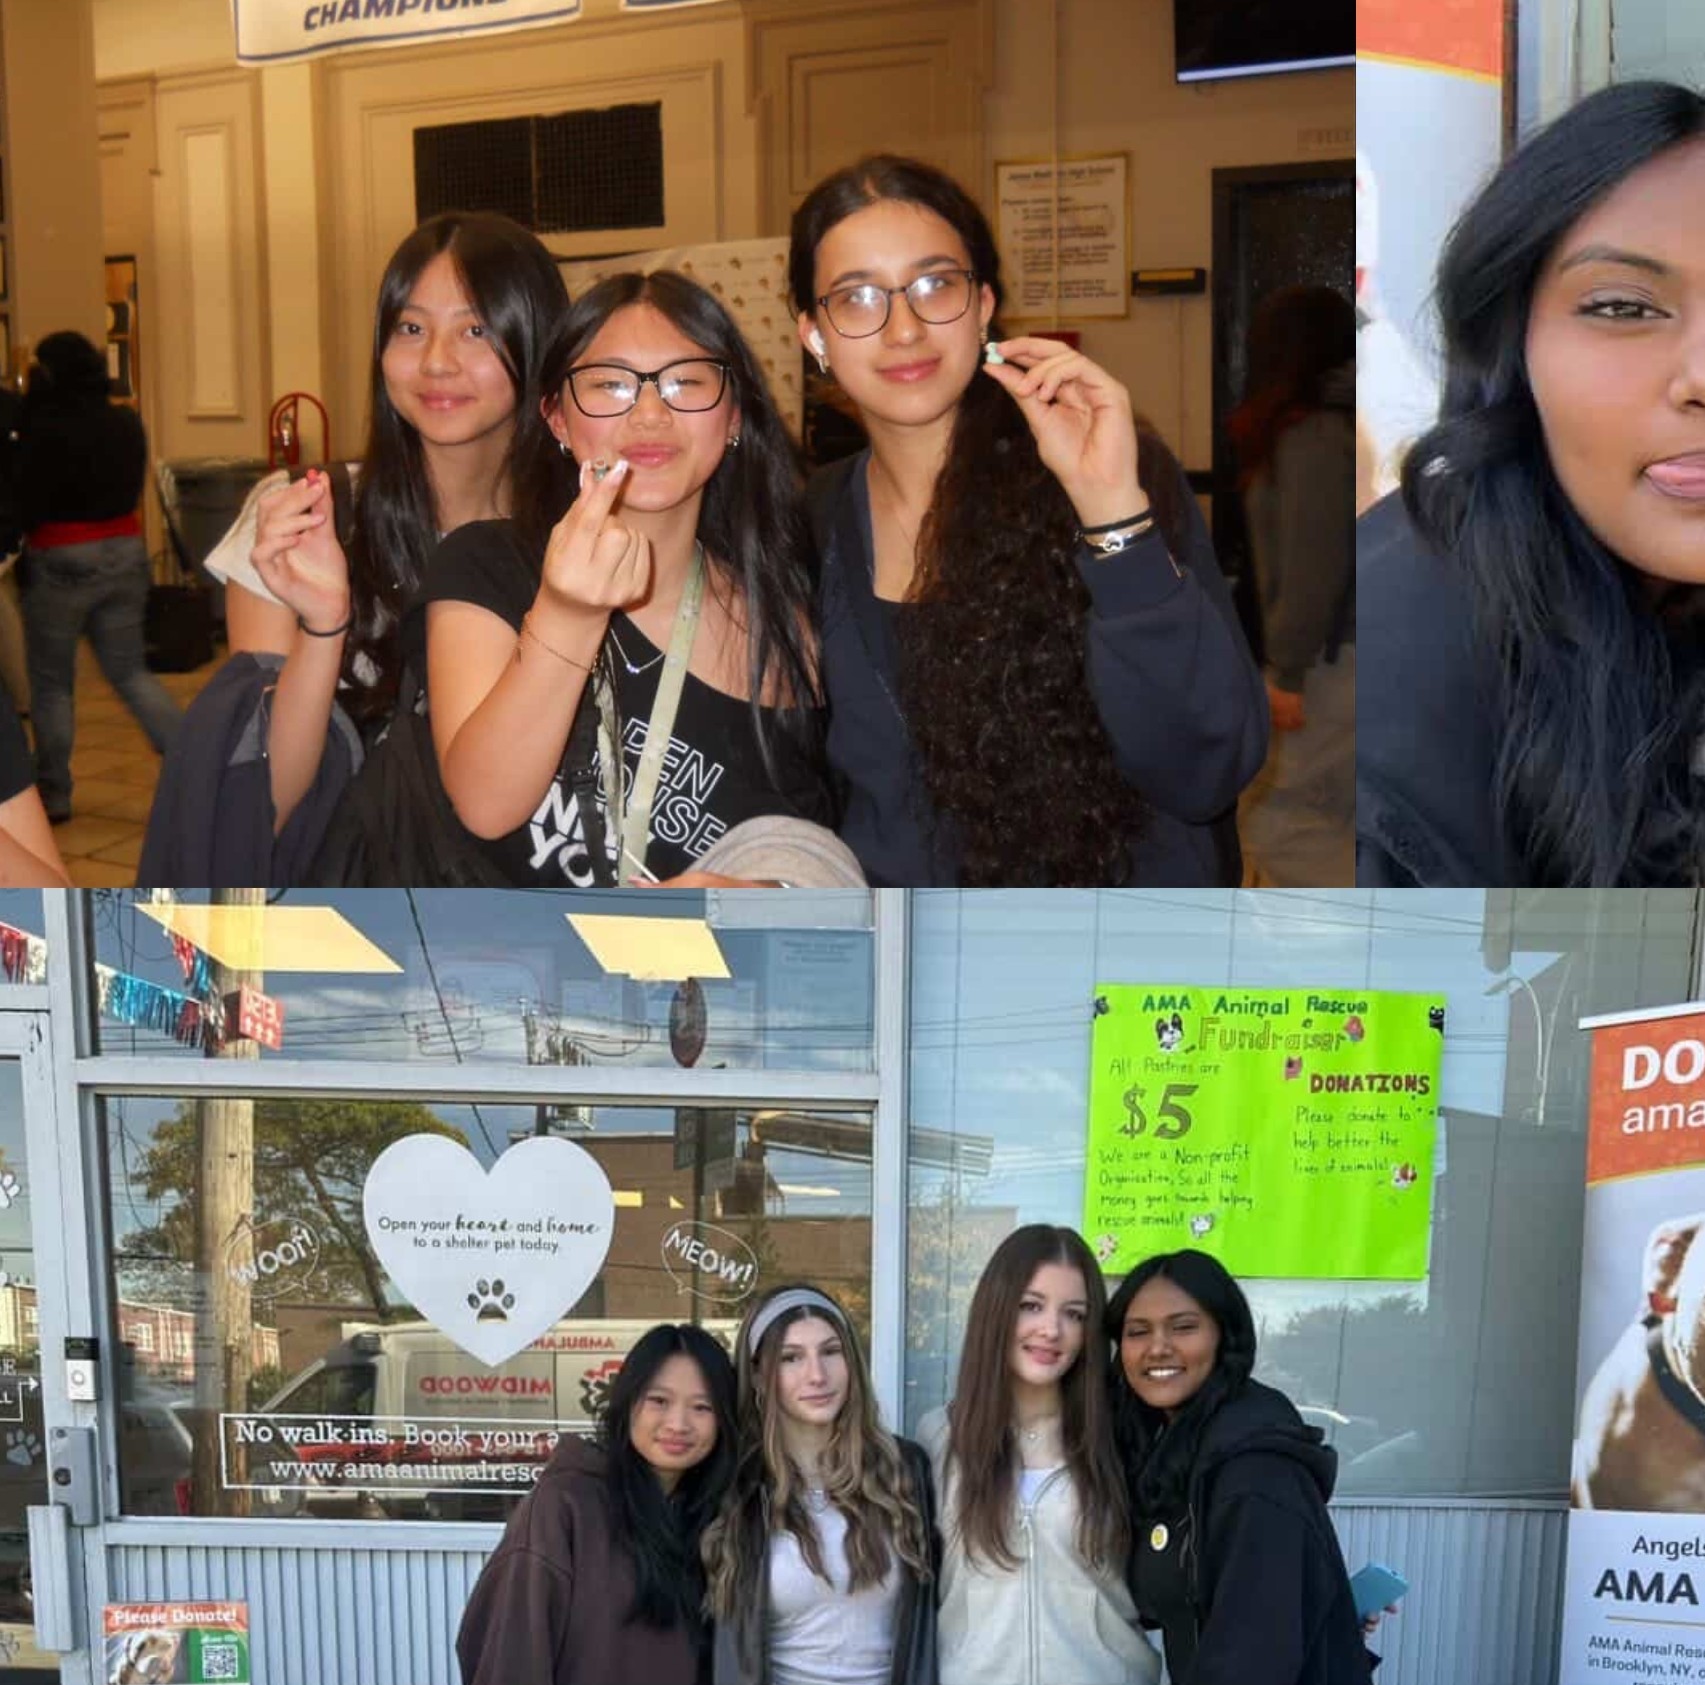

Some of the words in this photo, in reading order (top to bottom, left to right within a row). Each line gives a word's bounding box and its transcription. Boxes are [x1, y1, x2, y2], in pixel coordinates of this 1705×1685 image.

[1142, 995, 1192, 1012] AMA
[1212, 995, 1290, 1016] Animal
[1306, 996, 1369, 1014] Rescue
[1309, 1072, 1431, 1096] DONATIONS
[1117, 1082, 1200, 1141] $5
[378, 1215, 418, 1234] Open
[419, 1219, 454, 1235] your
[516, 1219, 543, 1233] and
[413, 1236, 427, 1249] to
[445, 1235, 489, 1250] shelter
[494, 1237, 517, 1253] pet
[664, 1229, 753, 1291] MEOW!
[235, 1419, 273, 1444] No
[278, 1419, 394, 1446] walk-ins.
[404, 1423, 467, 1447] Book
[1593, 1568, 1700, 1607] AMA
[114, 1609, 168, 1625] Please
[172, 1607, 237, 1624] Donate!
[1588, 1635, 1620, 1651] AMA
[1623, 1639, 1672, 1656] Animal
